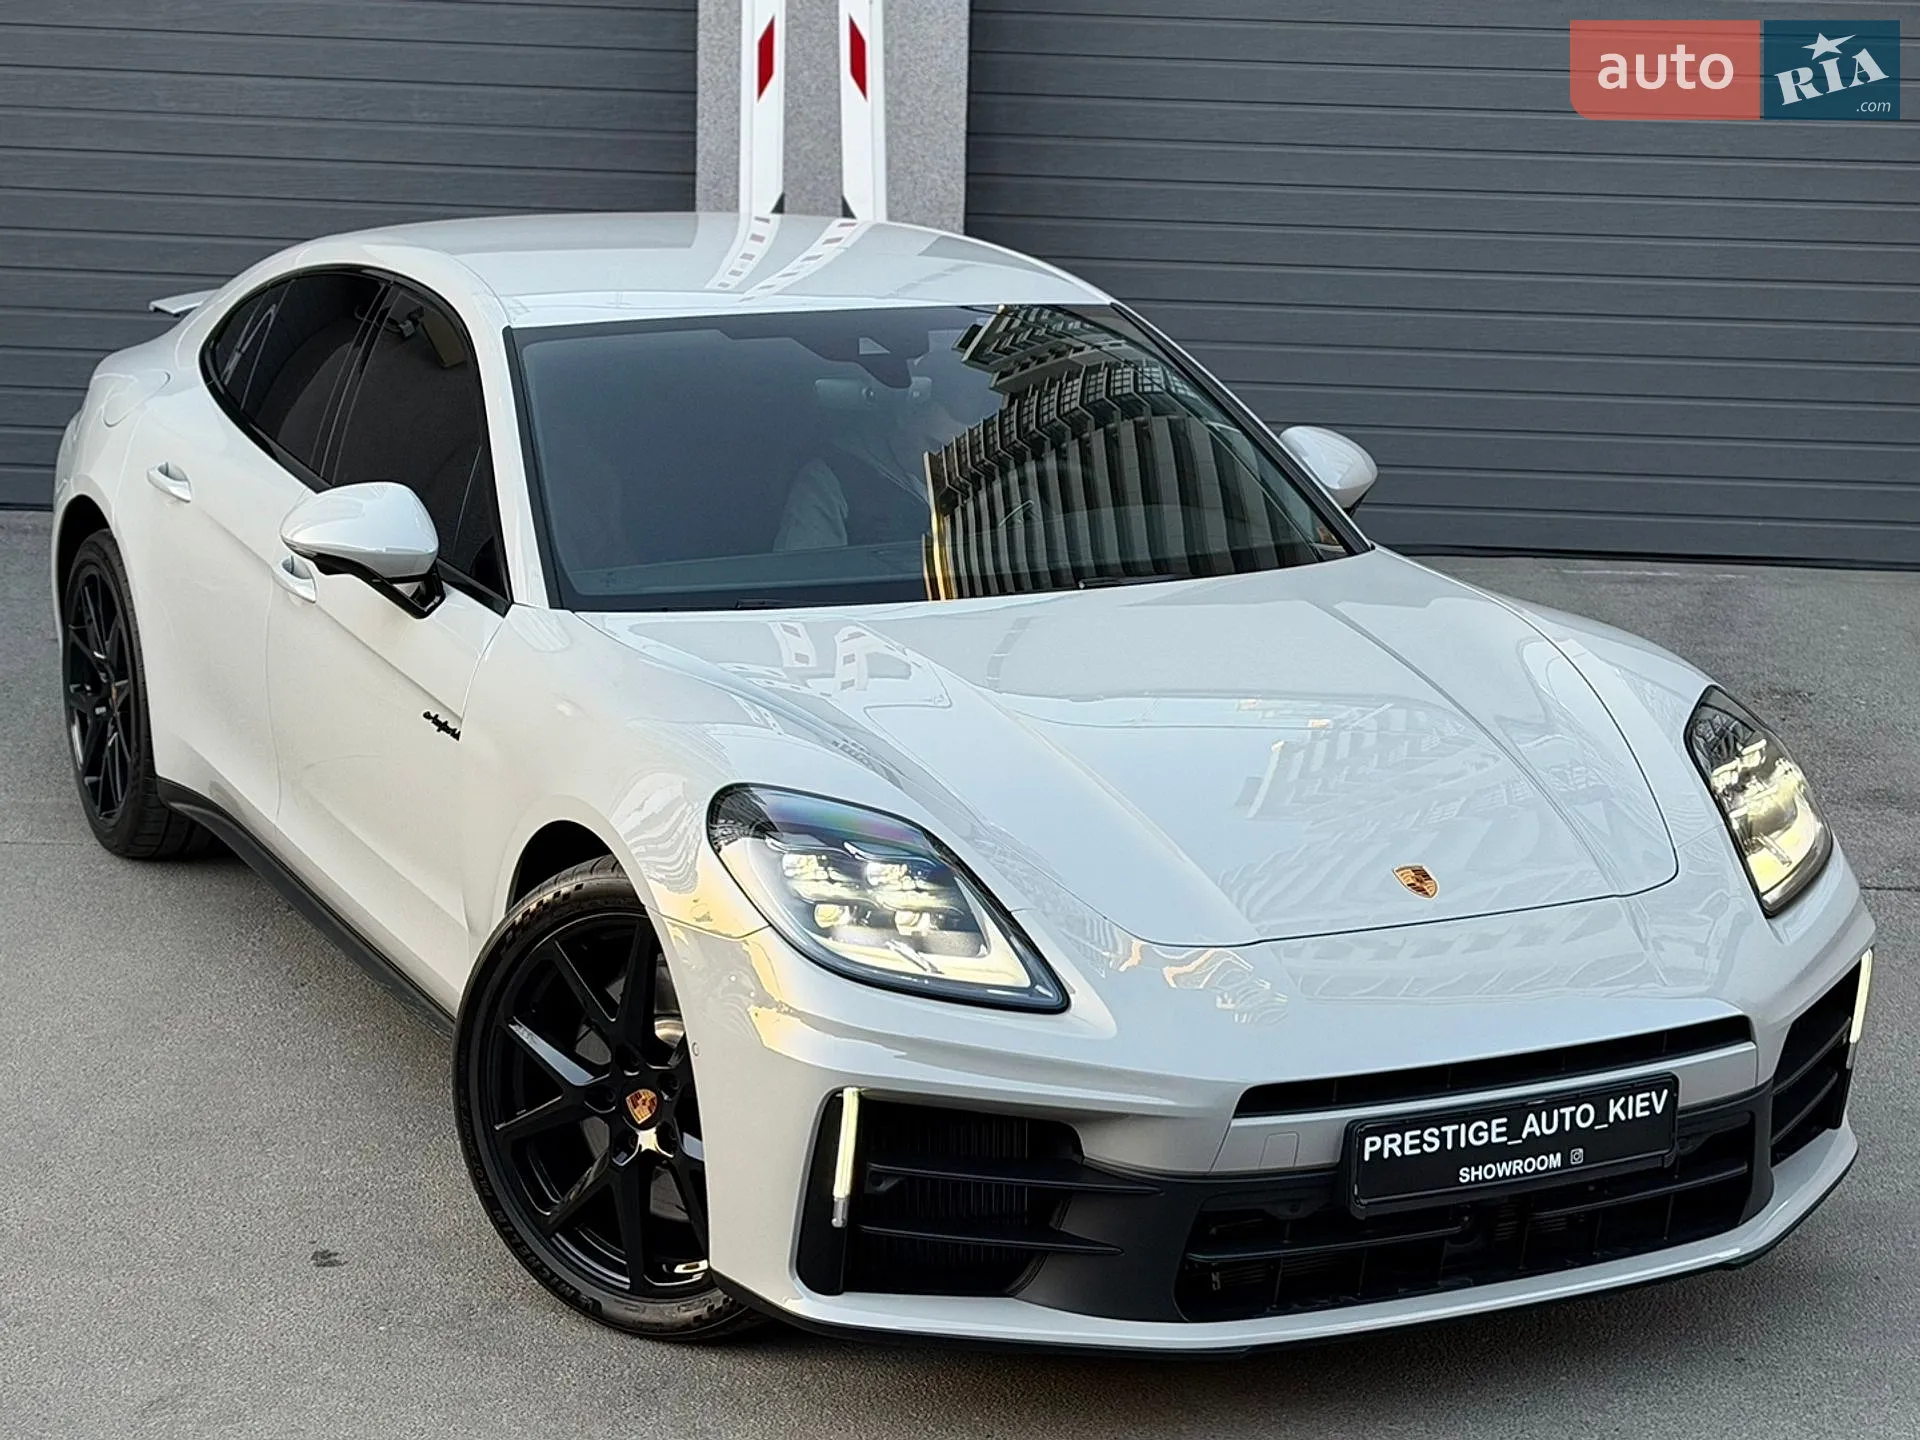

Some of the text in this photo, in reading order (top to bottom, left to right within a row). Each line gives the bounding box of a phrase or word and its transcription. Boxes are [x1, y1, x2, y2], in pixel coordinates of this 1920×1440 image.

[1363, 1089, 1668, 1161] PRESTIGE_AUTO_KIEV
[1458, 1153, 1561, 1183] SHOWROOM
[493, 1208, 576, 1298] MICHELIN
